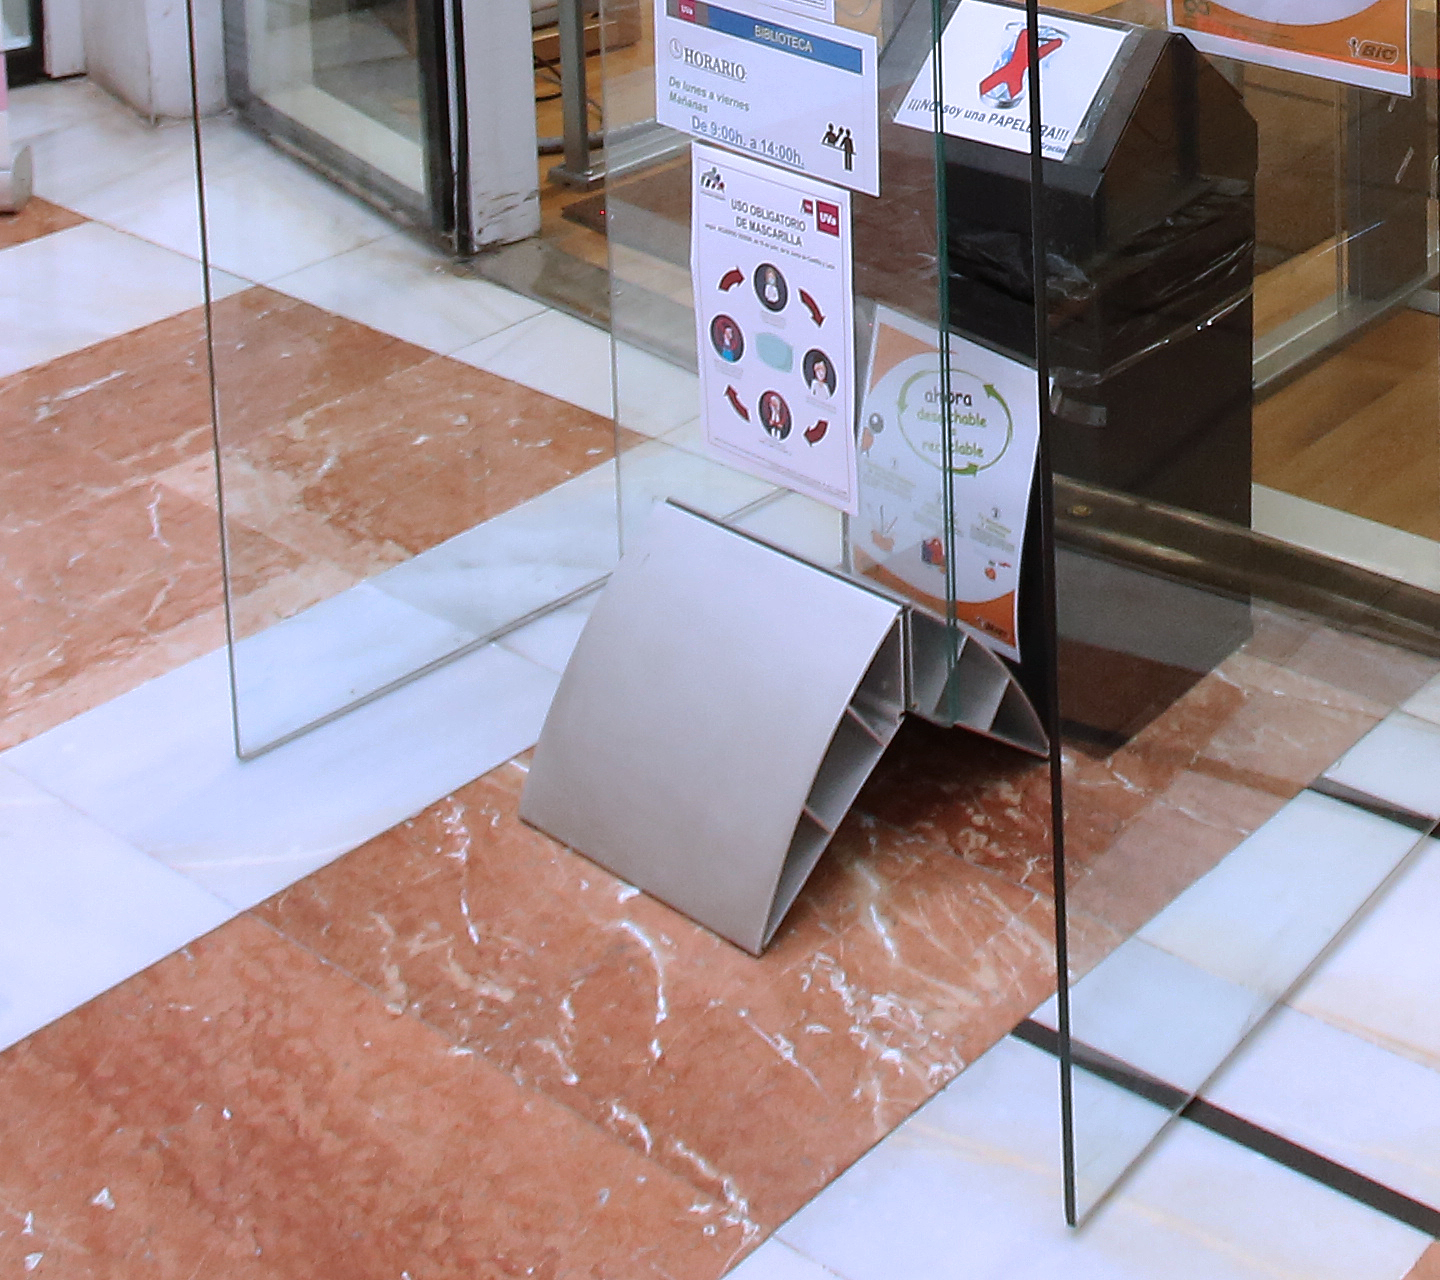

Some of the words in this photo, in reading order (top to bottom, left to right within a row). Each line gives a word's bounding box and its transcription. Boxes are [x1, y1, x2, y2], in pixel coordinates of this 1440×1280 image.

[754, 24, 814, 53] BIBLIOTECA
[1362, 42, 1397, 61] BIC
[668, 75, 681, 89] De
[682, 80, 707, 98] lunes
[716, 93, 750, 113] viernes
[943, 103, 964, 119] soy
[964, 110, 986, 123] una
[691, 115, 708, 133] De
[749, 138, 757, 150] a
[730, 198, 749, 214] USO
[749, 204, 807, 232] OBLIGATORIO
[819, 211, 837, 227] UVa
[735, 215, 747, 229] DE
[748, 219, 803, 247] MASCARILLA
